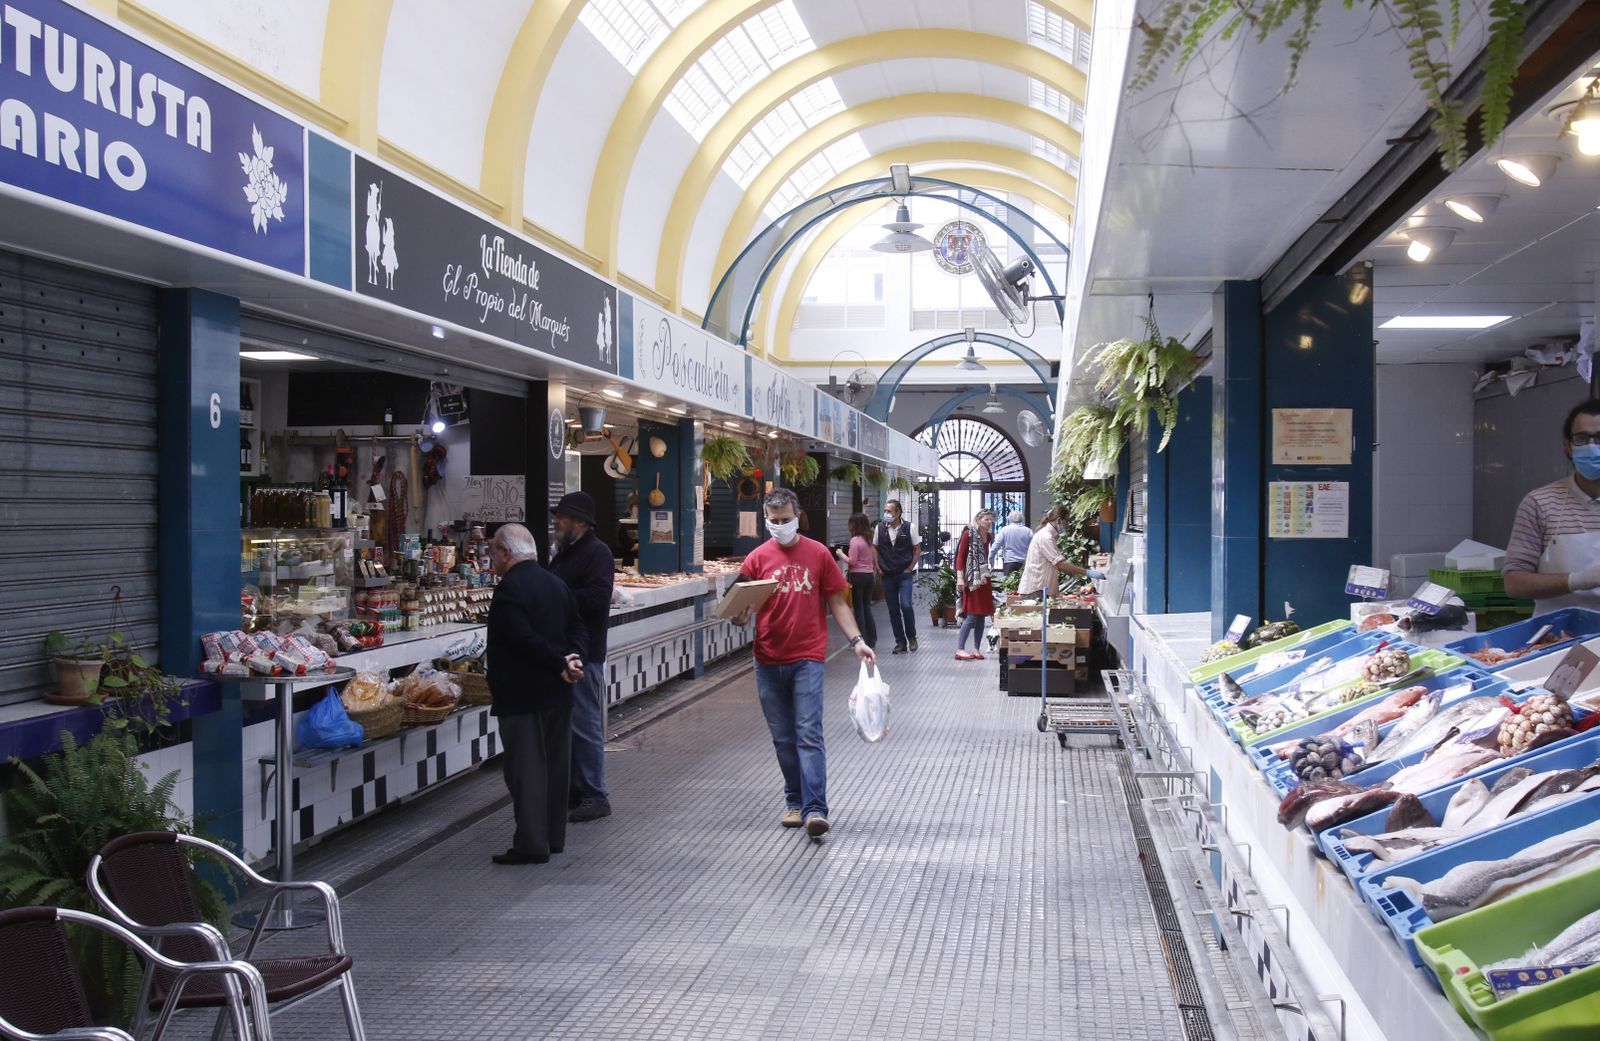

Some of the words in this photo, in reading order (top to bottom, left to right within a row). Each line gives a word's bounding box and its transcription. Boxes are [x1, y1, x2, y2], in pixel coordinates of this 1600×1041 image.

[0, 4, 212, 154] TURISTA
[480, 234, 493, 279] La
[492, 235, 528, 286] Tienda
[528, 261, 540, 291] de
[443, 263, 463, 302] El
[463, 272, 504, 324] Propio
[508, 287, 526, 321] del
[529, 293, 571, 349] Marqués
[209, 392, 222, 429] 6
